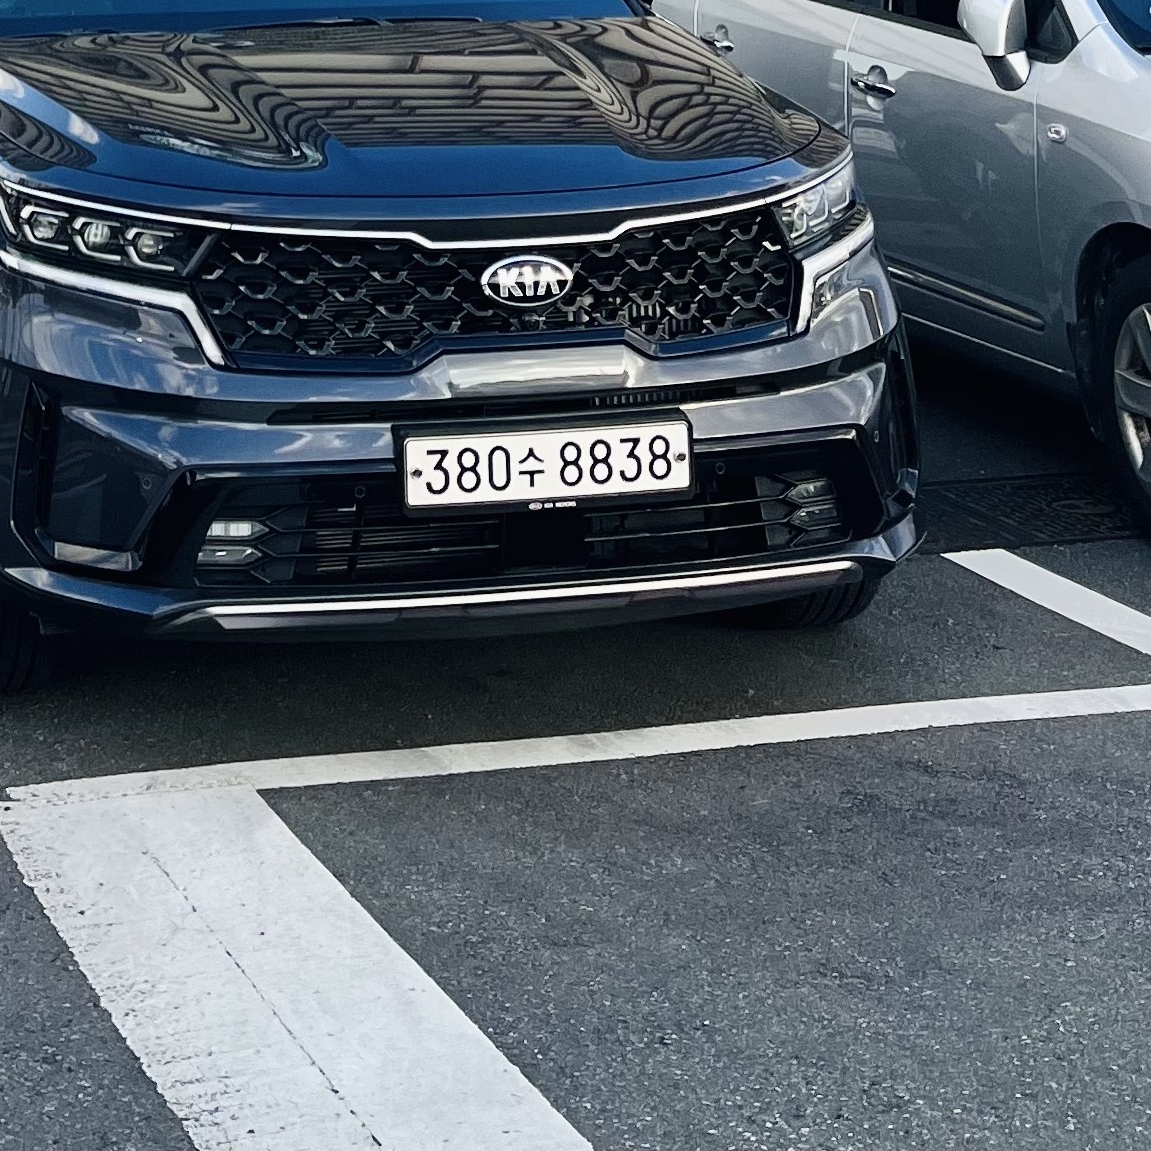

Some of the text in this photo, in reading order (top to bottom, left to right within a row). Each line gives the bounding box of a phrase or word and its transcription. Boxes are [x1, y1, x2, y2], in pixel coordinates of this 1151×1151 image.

[497, 265, 560, 297] KIA
[425, 434, 672, 495] 380수 8838
